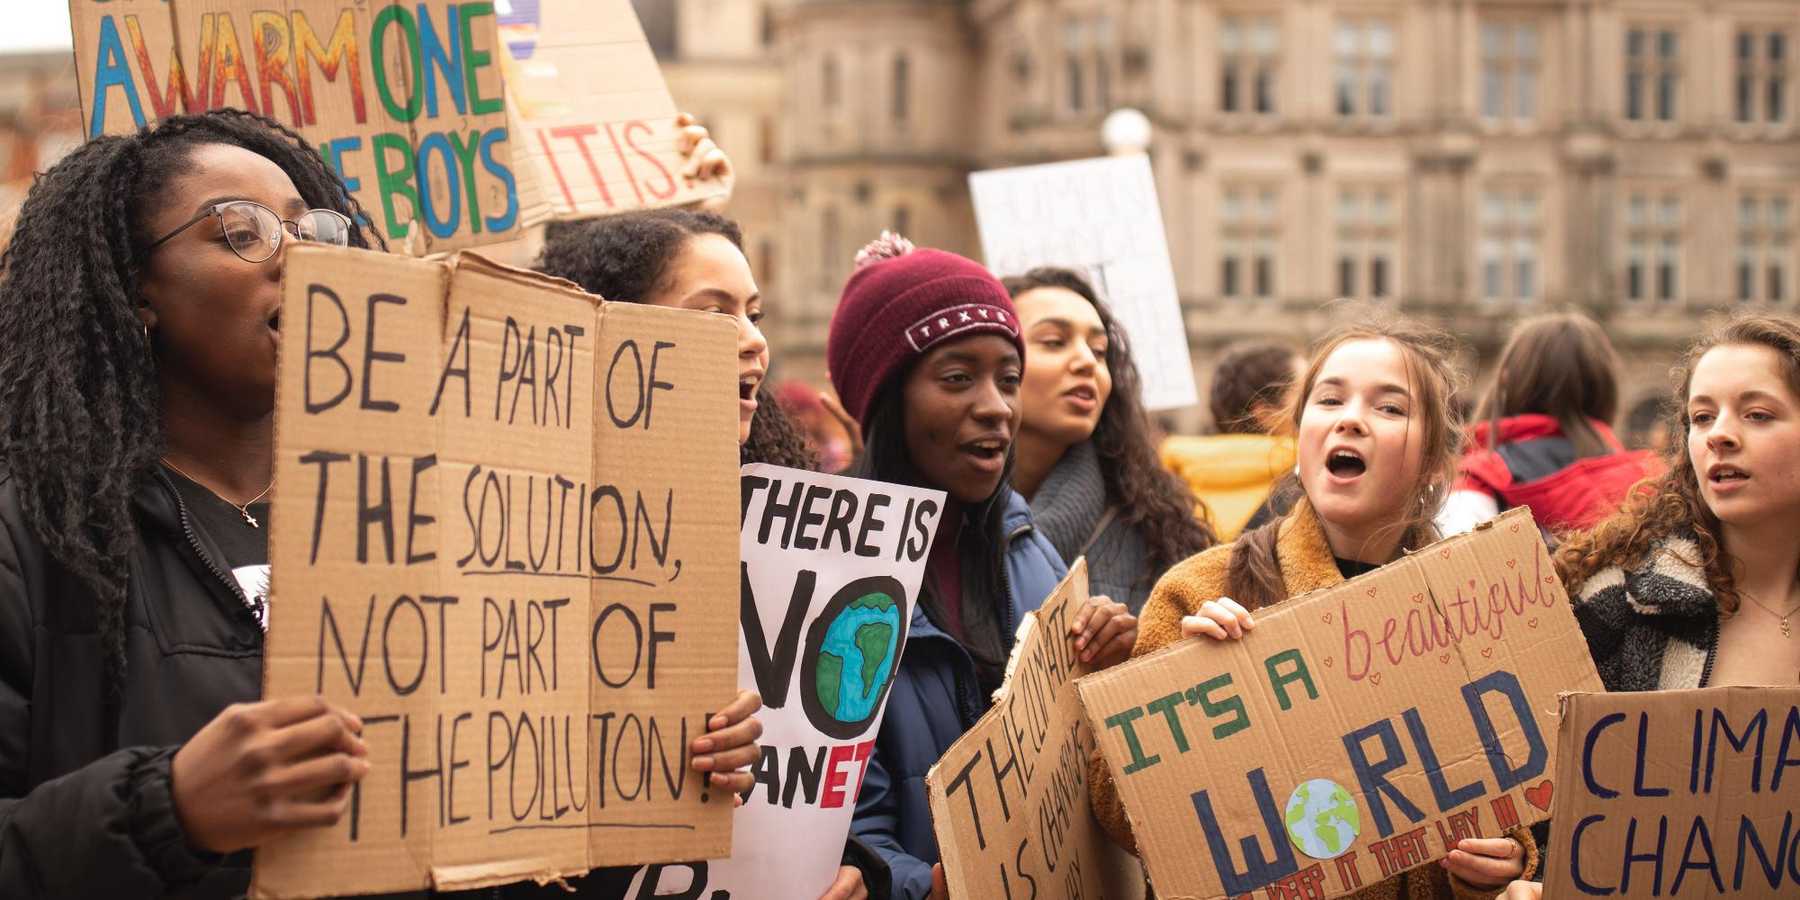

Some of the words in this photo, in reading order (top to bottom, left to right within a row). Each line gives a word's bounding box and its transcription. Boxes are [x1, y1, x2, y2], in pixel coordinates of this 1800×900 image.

[90, 15, 147, 138] A
[124, 7, 367, 128] WARM
[370, 2, 504, 122] ONE
[372, 127, 518, 239] BOYS
[537, 124, 615, 213] IT
[304, 283, 407, 414] BE
[429, 306, 472, 417] A
[495, 316, 585, 429] PART
[605, 339, 676, 430] OF
[299, 451, 438, 567] THE
[457, 465, 682, 582] SOLUTION,
[741, 475, 891, 557] THERE
[896, 497, 938, 562] IS
[316, 595, 458, 696] NOT
[481, 596, 570, 698] PART
[592, 602, 677, 689] OF
[1342, 540, 1555, 681] beautiful
[945, 692, 1034, 851] THE
[1021, 598, 1076, 754] CLIMATE
[1264, 648, 1320, 711] A
[348, 712, 473, 842] THE
[1333, 850, 1362, 892] IT
[1367, 826, 1431, 879] THAT
